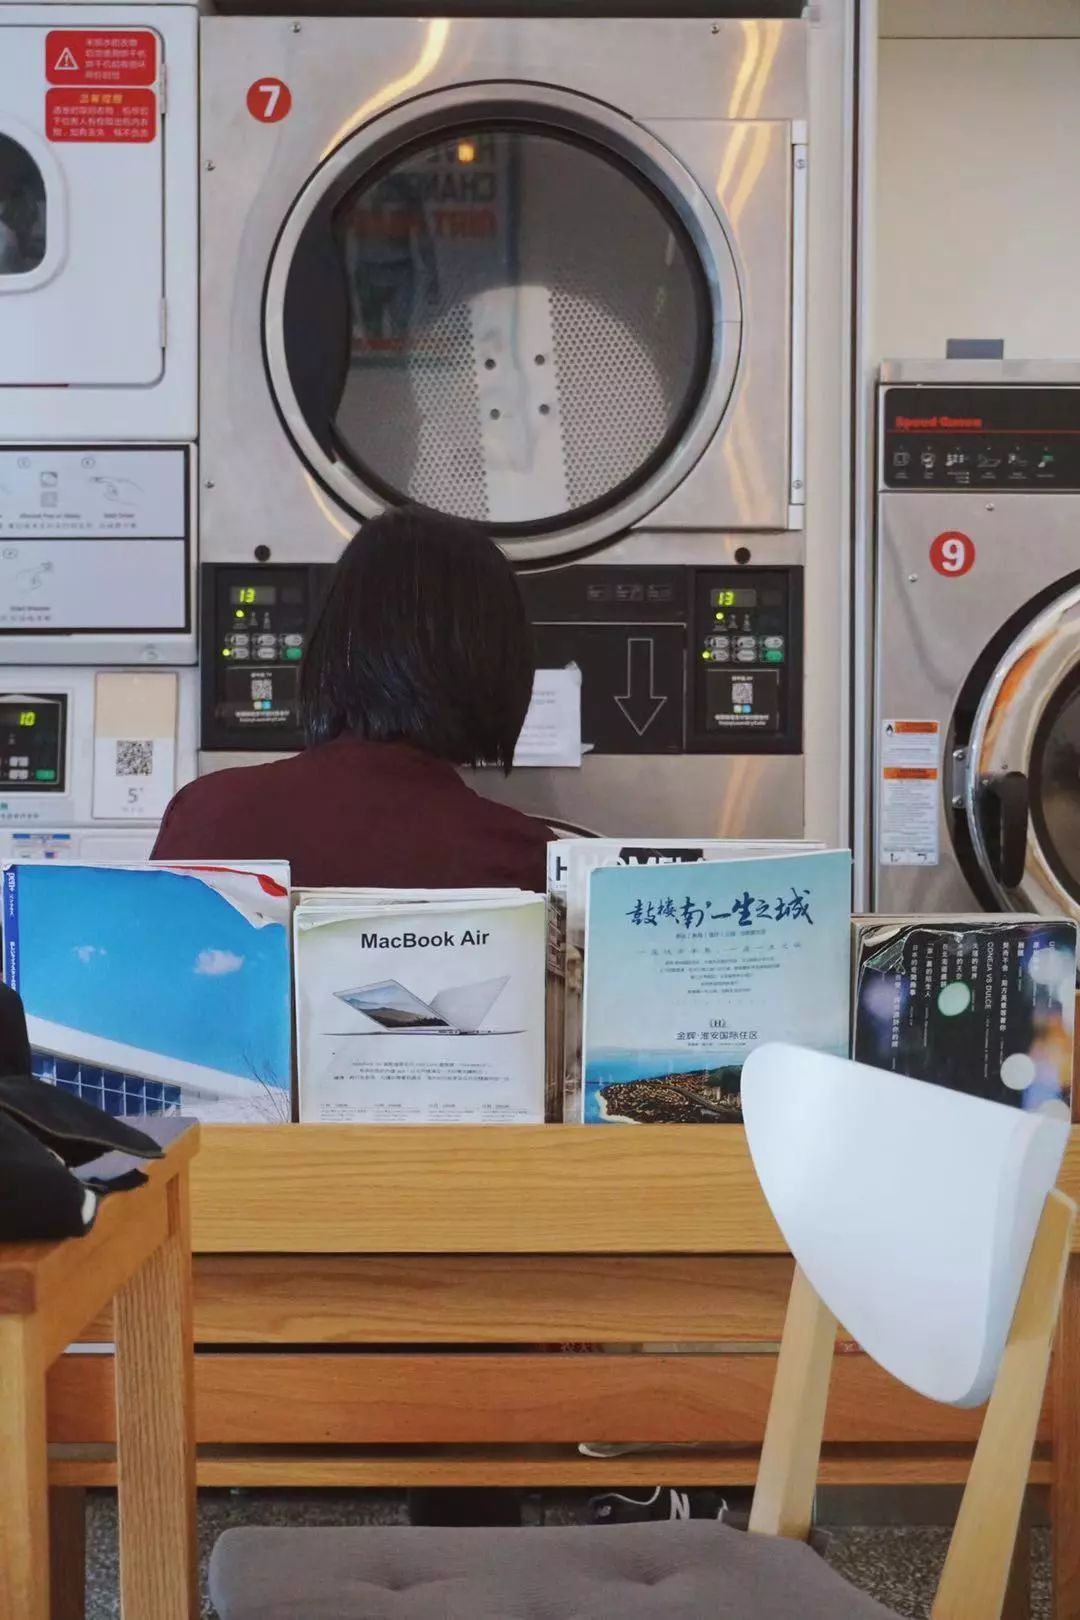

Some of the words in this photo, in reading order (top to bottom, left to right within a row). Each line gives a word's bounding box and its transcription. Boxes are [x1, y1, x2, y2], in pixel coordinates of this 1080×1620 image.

[259, 85, 281, 117] 7
[941, 539, 966, 572] 9
[239, 588, 256, 603] 13
[718, 591, 734, 606] 13
[19, 712, 35, 726] 10
[361, 931, 455, 949] MacBook
[460, 929, 490, 946] Air
[986, 973, 993, 984] VS
[984, 985, 992, 1009] DULCE
[669, 1488, 690, 1520] N
